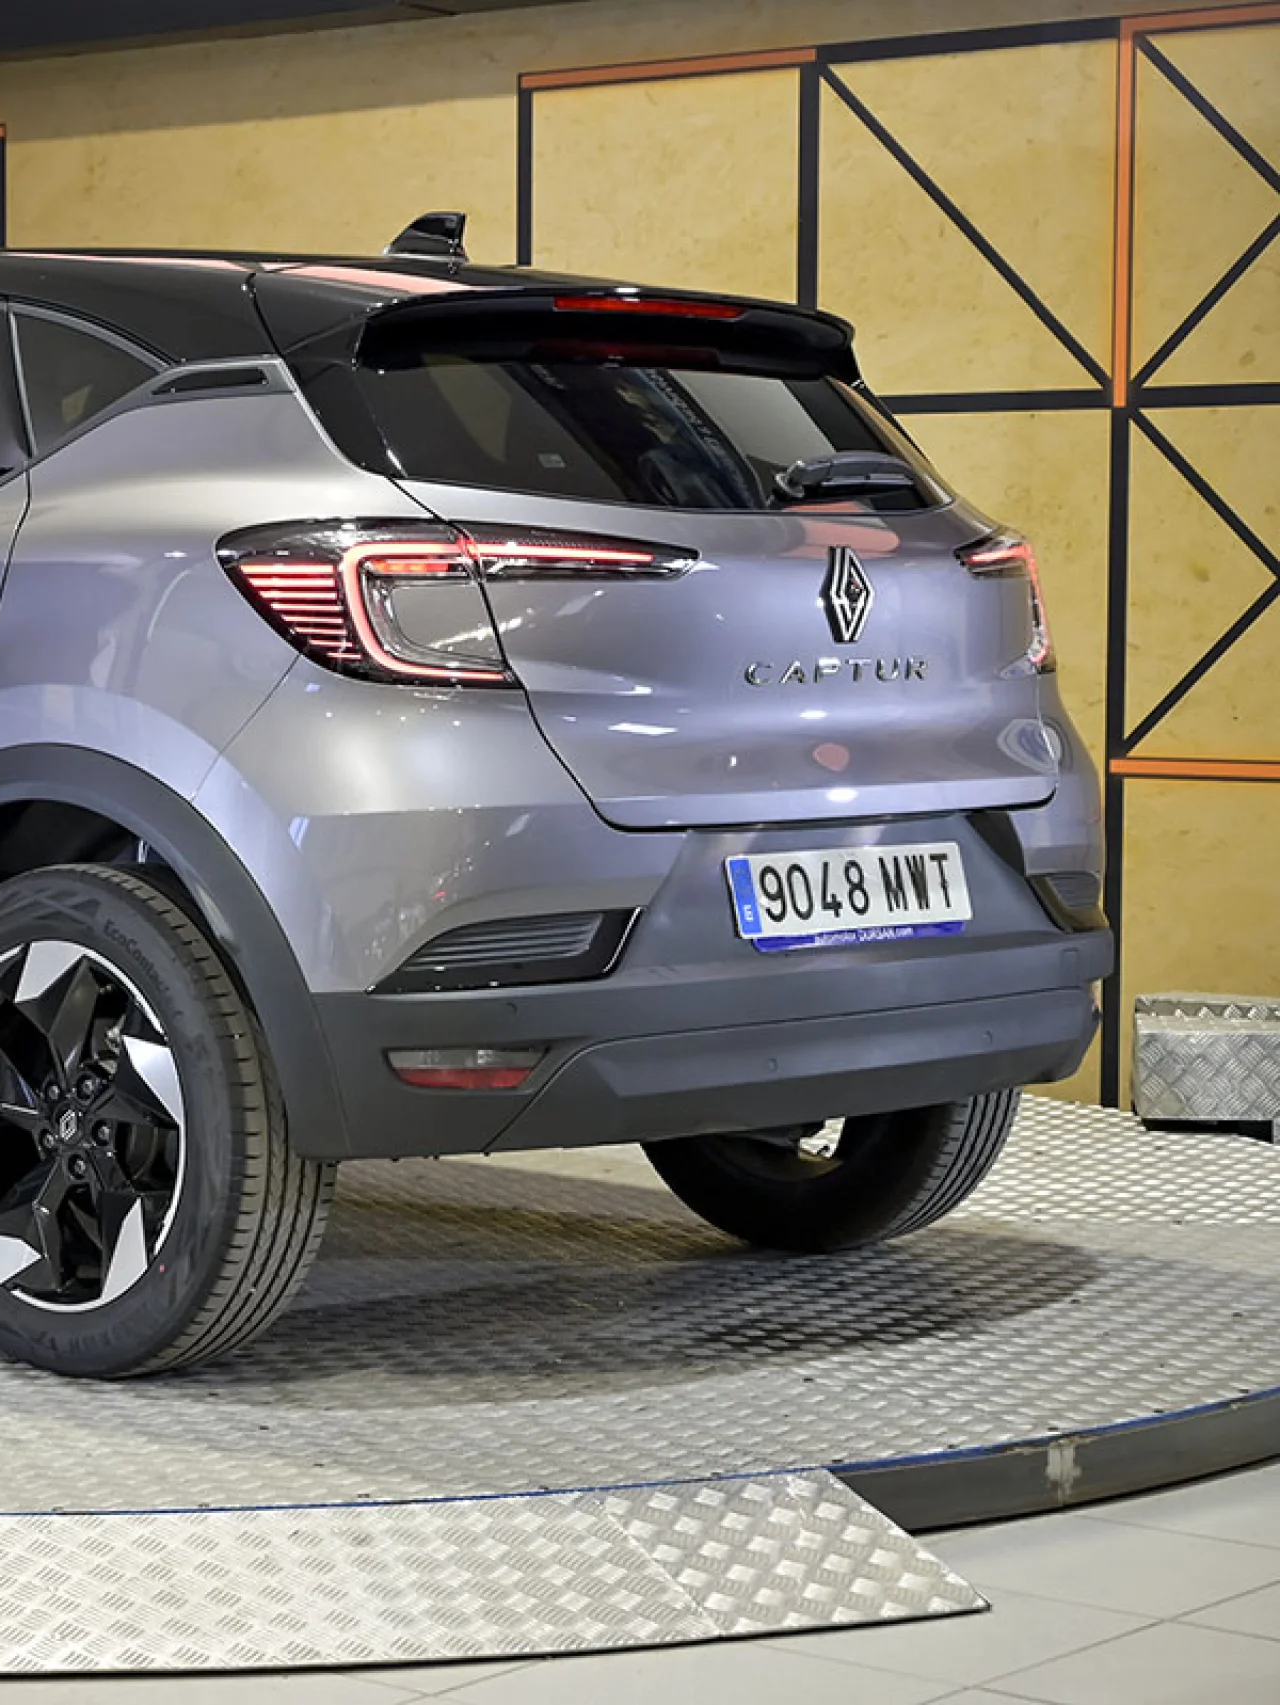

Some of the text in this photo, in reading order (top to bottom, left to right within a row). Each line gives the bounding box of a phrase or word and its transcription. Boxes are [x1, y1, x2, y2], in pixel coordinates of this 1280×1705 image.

[744, 654, 929, 686] CAPTUR
[758, 853, 953, 923] 9048 MWT
